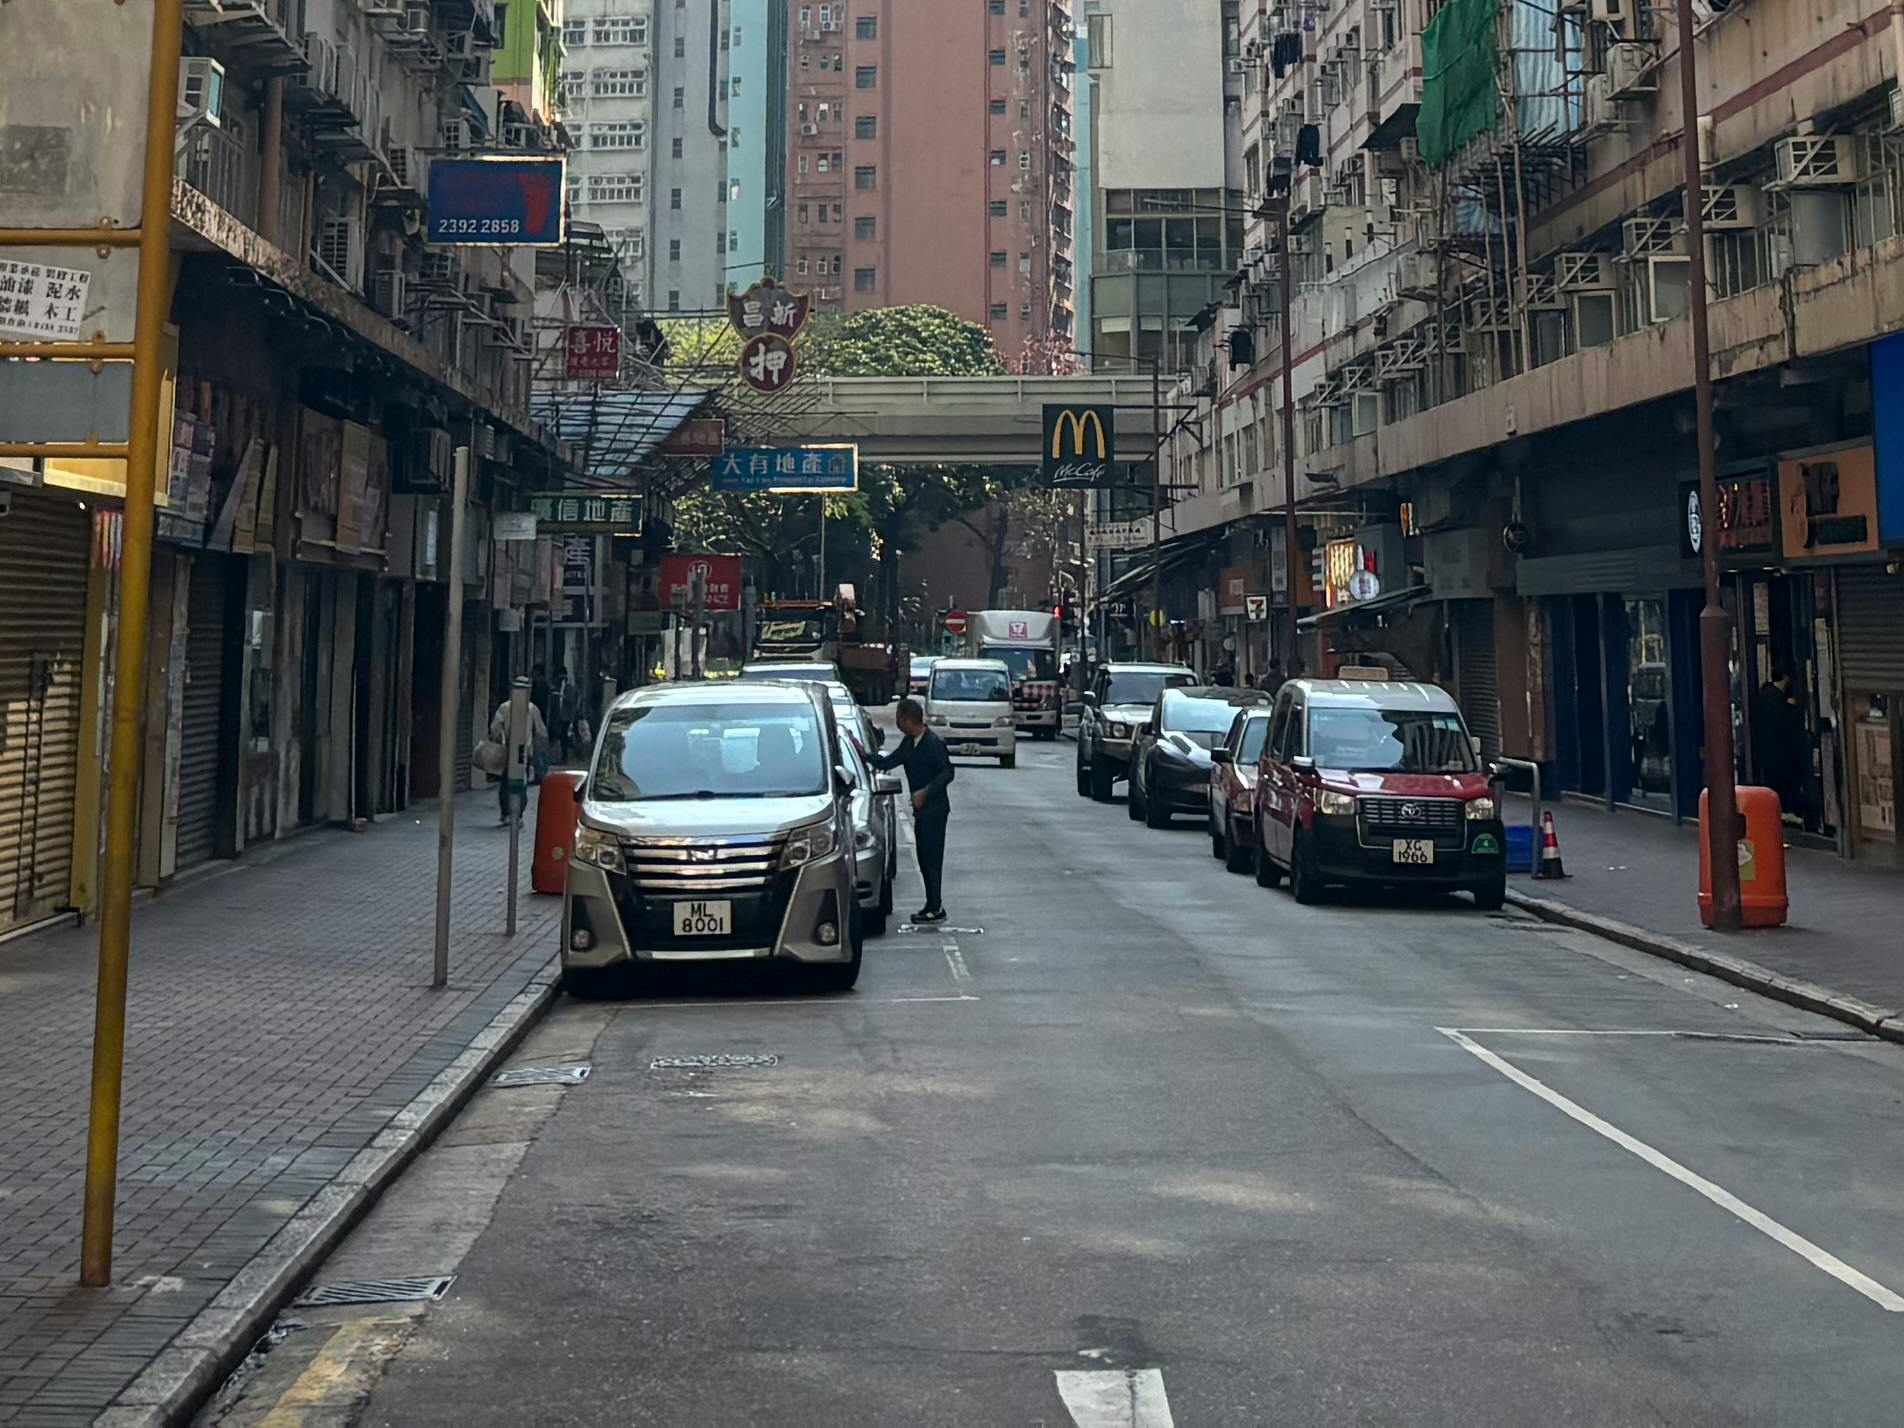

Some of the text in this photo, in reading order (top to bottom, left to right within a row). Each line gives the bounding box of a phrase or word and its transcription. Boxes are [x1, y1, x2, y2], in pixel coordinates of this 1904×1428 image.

[438, 219, 520, 234] 2392 2858
[749, 342, 788, 386] 押
[721, 452, 822, 476] 大有地產
[1405, 839, 1422, 851] XG
[1398, 850, 1428, 863] 1966
[690, 903, 715, 919] ML
[682, 917, 724, 934] 8001
